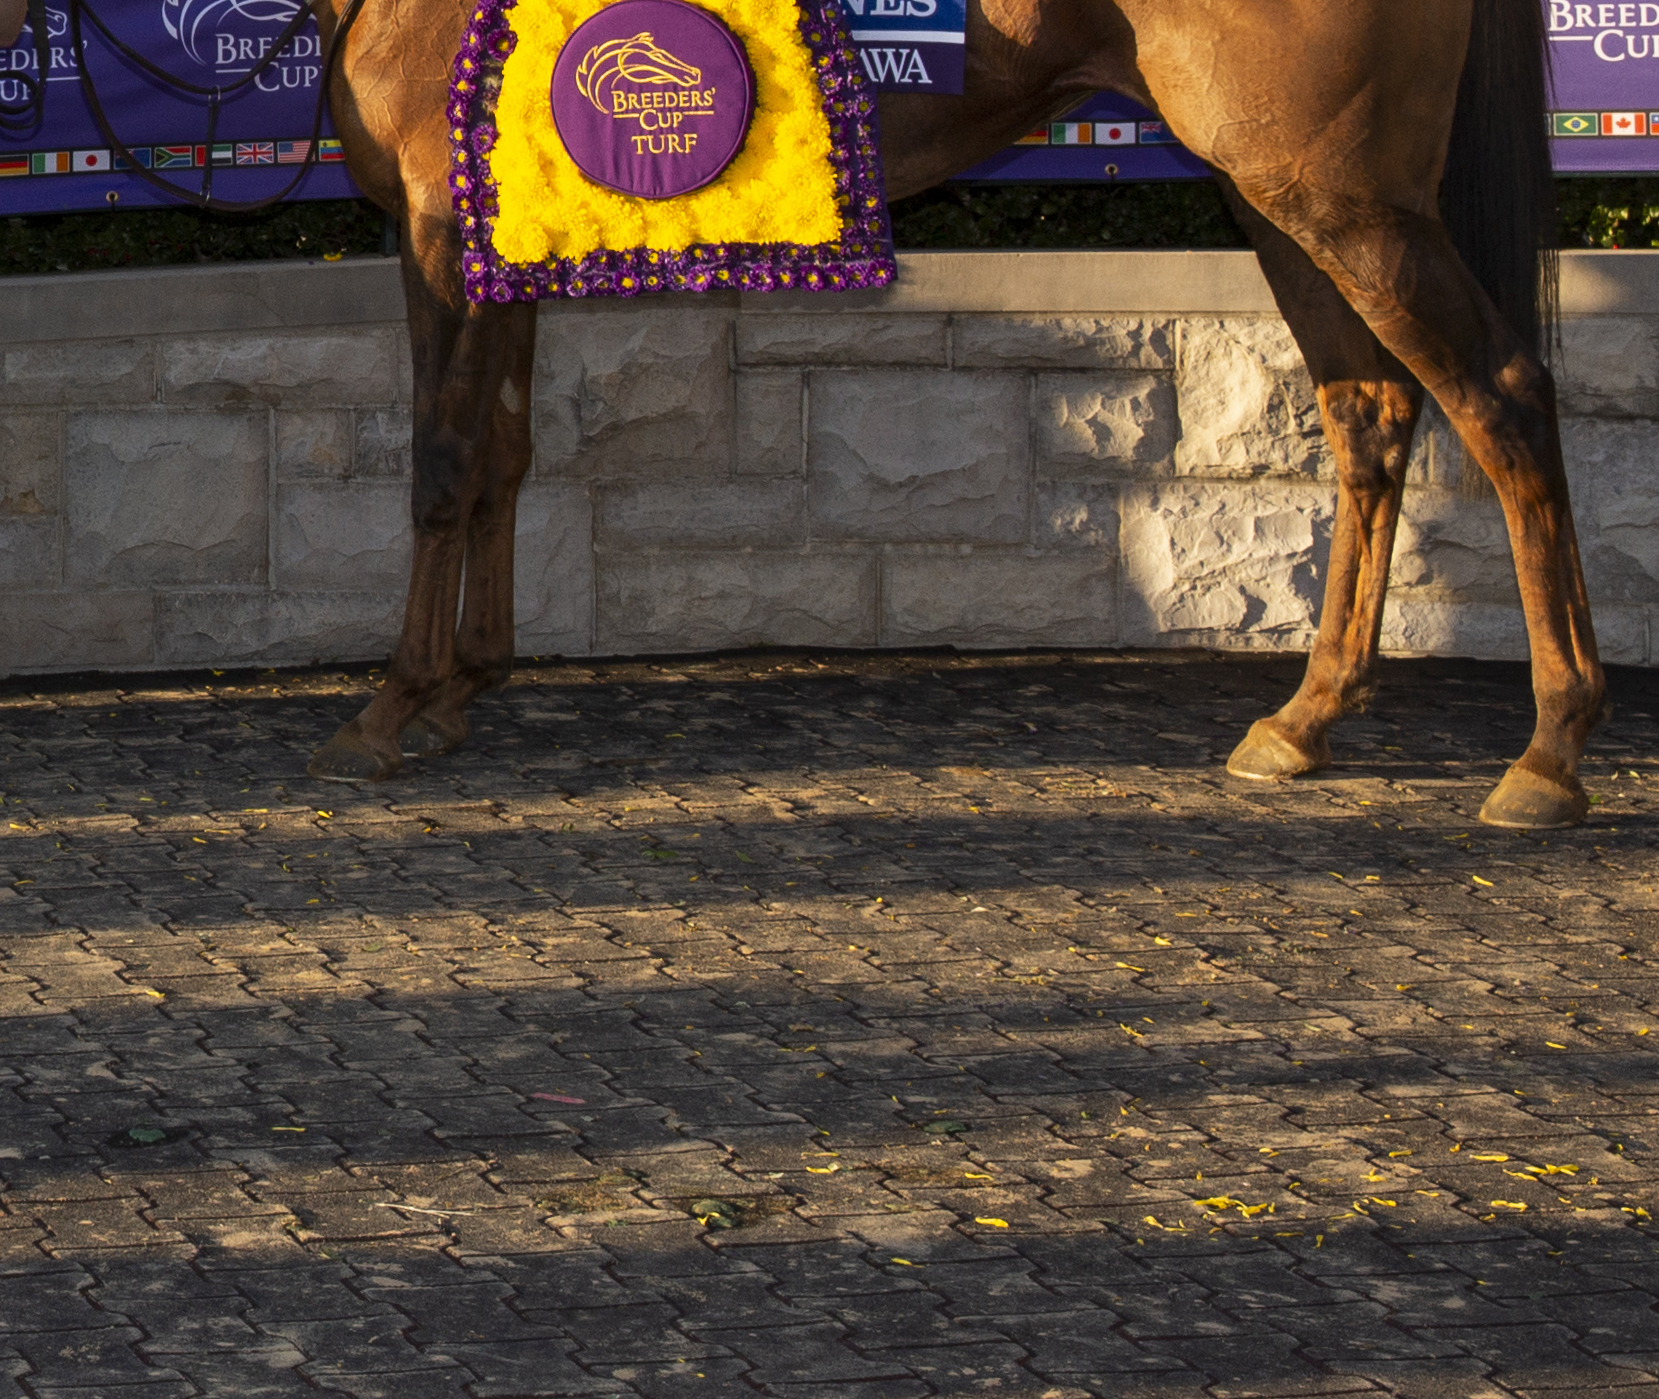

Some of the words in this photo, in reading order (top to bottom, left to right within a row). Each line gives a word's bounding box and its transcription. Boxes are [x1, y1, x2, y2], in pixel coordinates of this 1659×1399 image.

[254, 61, 319, 92] CUP
[610, 86, 716, 112] BREEDERS'
[639, 108, 683, 131] CUP
[631, 133, 698, 155] TURF
